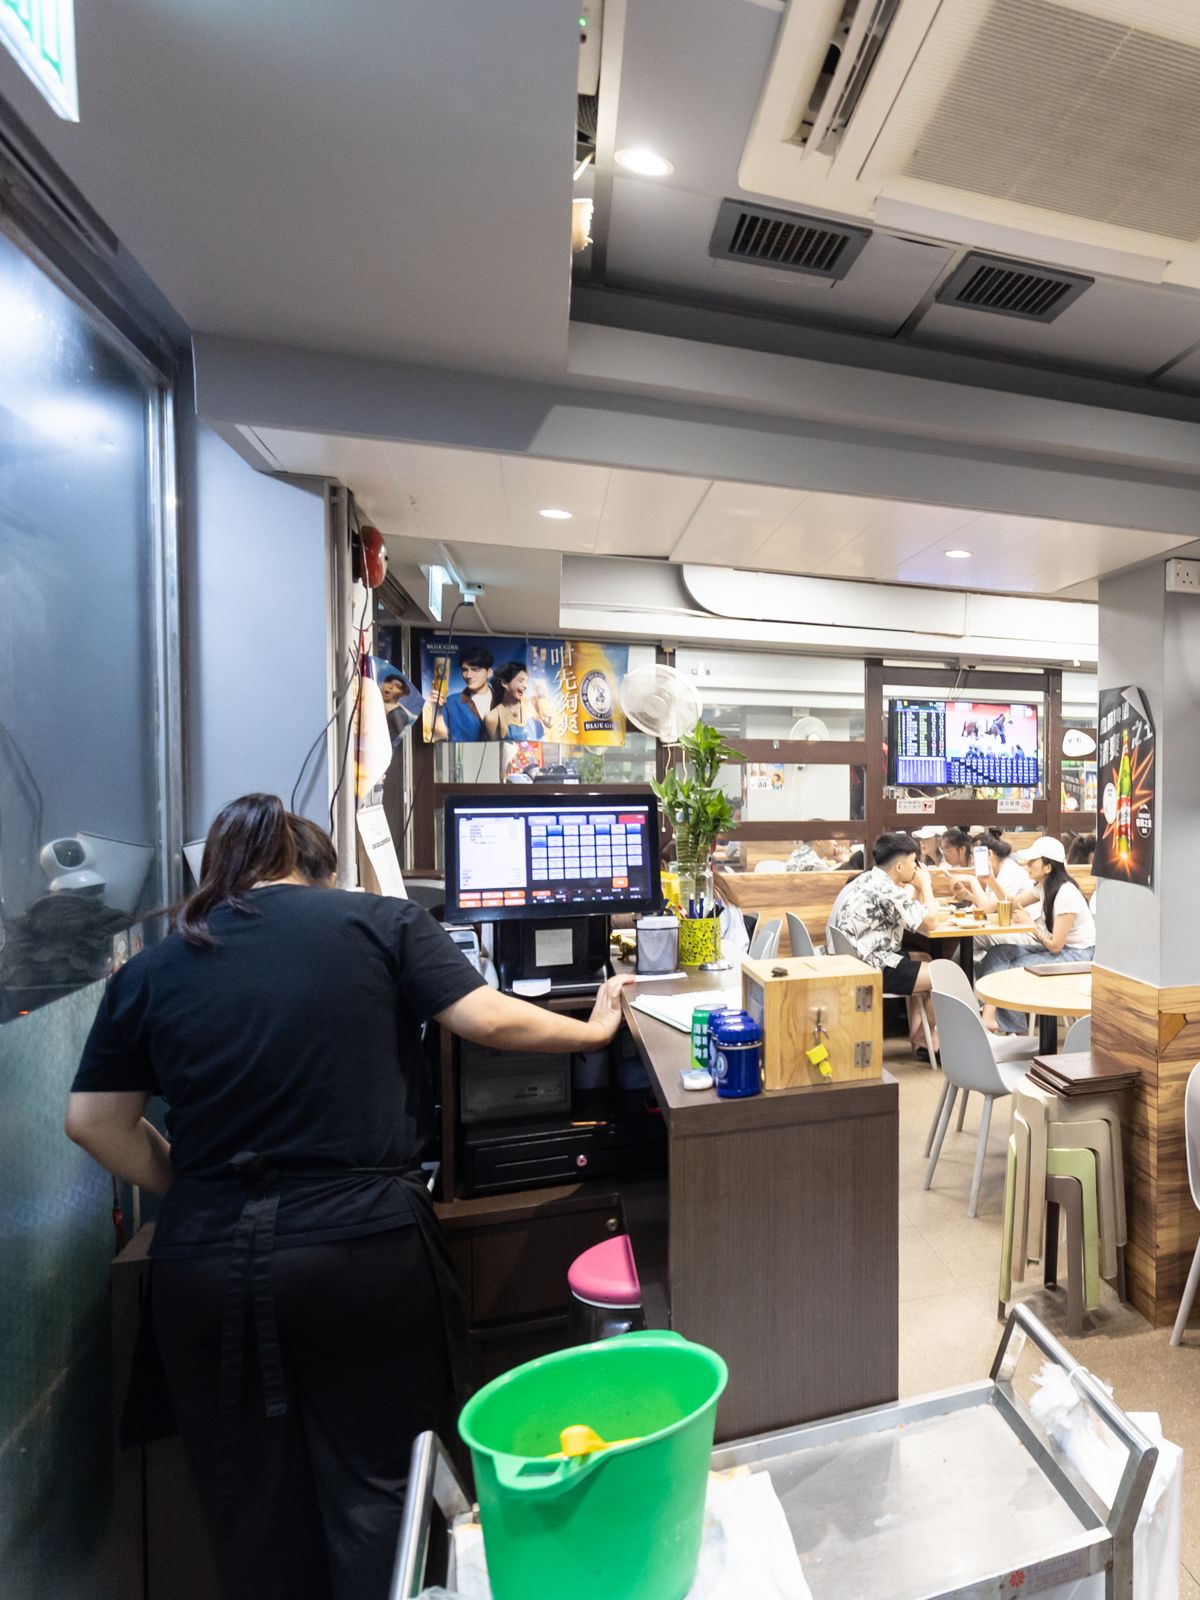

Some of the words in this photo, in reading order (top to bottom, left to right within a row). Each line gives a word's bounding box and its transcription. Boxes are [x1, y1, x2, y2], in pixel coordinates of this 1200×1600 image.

[550, 645, 580, 737] 咁先夠爽
[585, 722, 603, 730] BLUE
